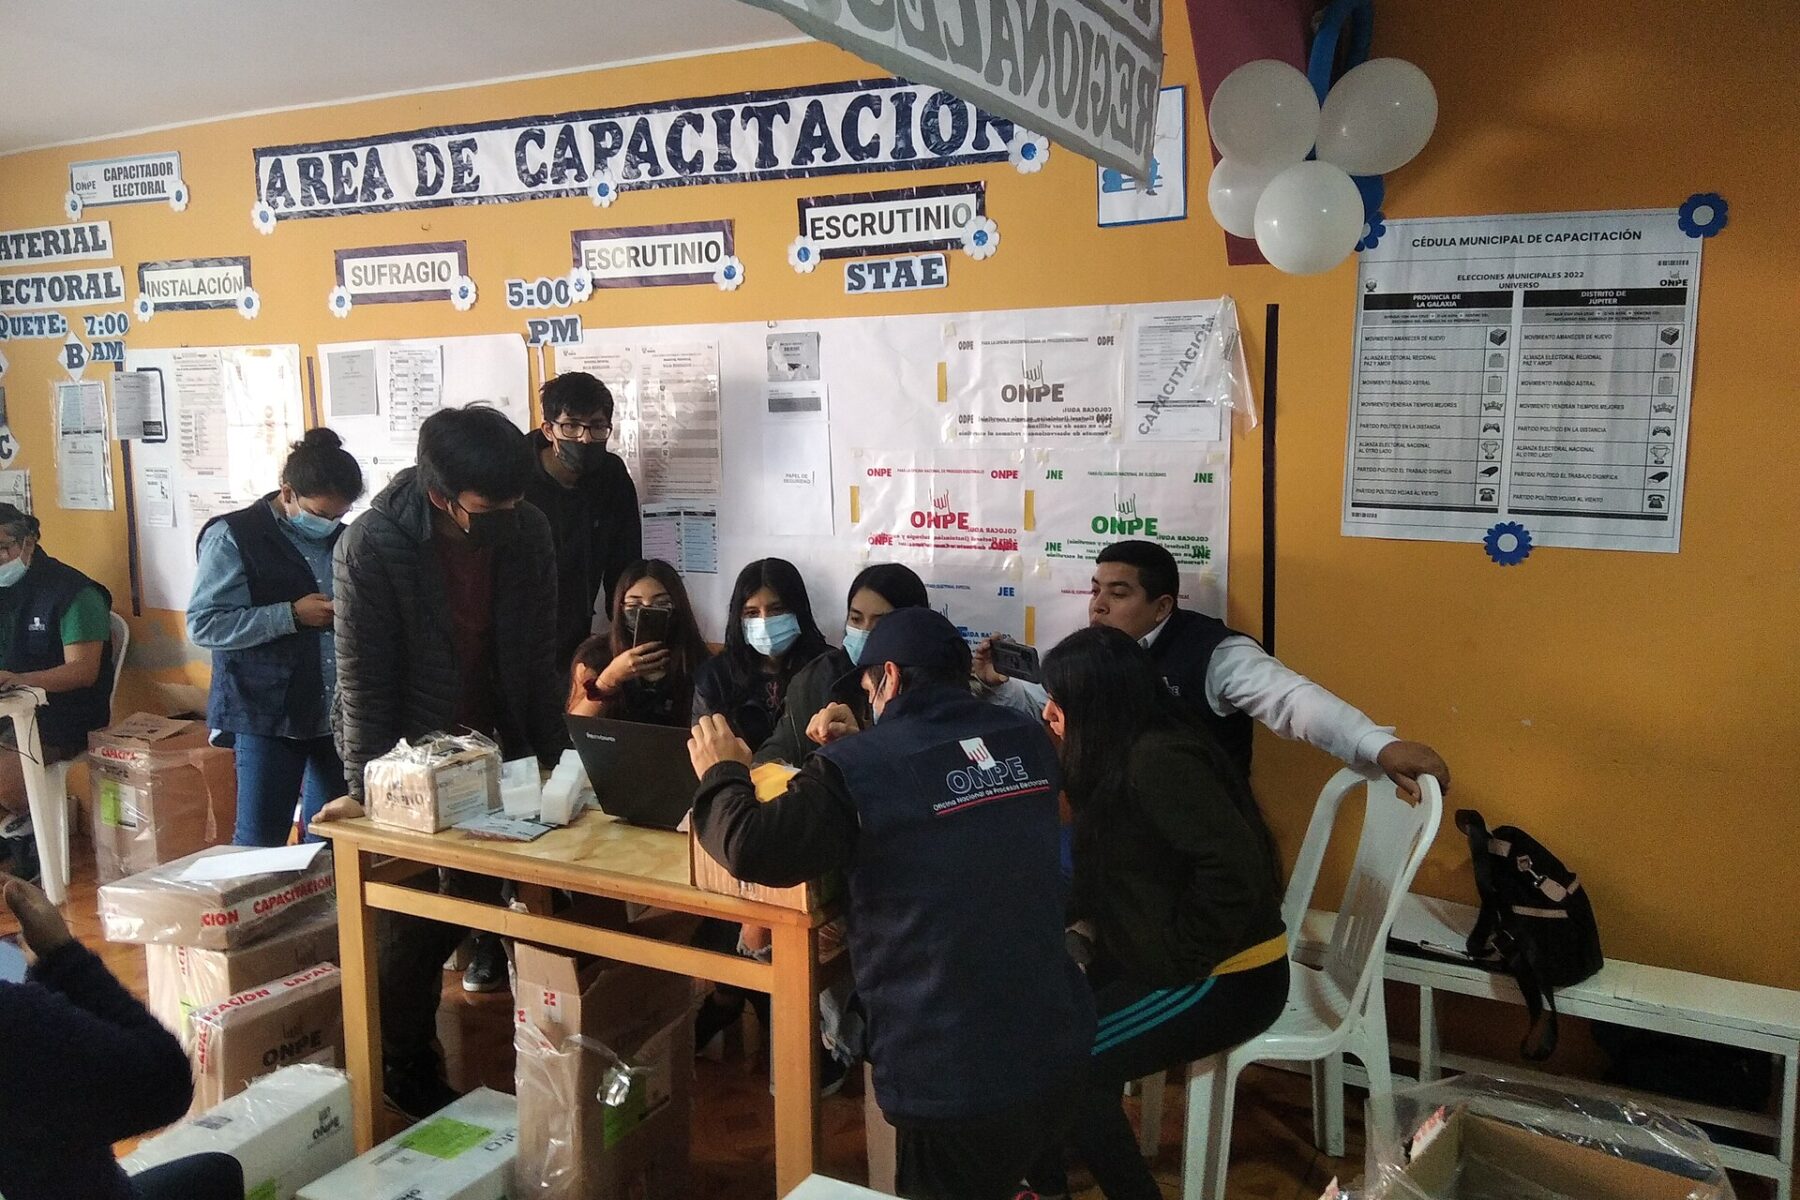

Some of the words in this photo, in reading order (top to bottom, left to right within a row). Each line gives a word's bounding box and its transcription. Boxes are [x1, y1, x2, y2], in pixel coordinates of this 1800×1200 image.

[103, 161, 174, 182] CAPACITADOR
[264, 146, 393, 209] AREA
[412, 138, 482, 198] DE
[75, 180, 97, 191] ONPE
[112, 180, 167, 198] ELECTORAL
[810, 200, 972, 241] ESCRUTINIO
[1412, 236, 1457, 247] CÉDULA
[1459, 234, 1524, 246] MUNICIPAL
[1527, 234, 1542, 243] DE
[1545, 229, 1642, 243] CAPACITACIÓN
[584, 242, 721, 272] ESCRUTINIO
[350, 256, 452, 287] SUFRAGIO
[846, 256, 945, 292] STAE
[1457, 273, 1504, 281] ELECCIONES
[1507, 272, 1561, 280] MUNICIPALES
[146, 272, 243, 298] INSTALACIÓN
[1660, 279, 1688, 287] ONPE
[507, 281, 570, 307] 5:00
[1581, 290, 1614, 298] DISTRITO
[83, 313, 128, 336] 7:00
[528, 316, 580, 345] PM
[958, 341, 974, 350] ODPE
[1097, 336, 1114, 346] ODPE
[64, 342, 85, 369] B
[91, 341, 124, 361] AM
[1001, 383, 1064, 402] ONPE
[958, 414, 974, 424] ODPE
[867, 468, 892, 477] ONPE
[990, 470, 1018, 479] ONPE
[1045, 470, 1063, 480] JNE
[1193, 472, 1213, 483] JNE
[910, 511, 969, 530] ONPE
[1091, 515, 1158, 536] ONPE
[1045, 542, 1062, 552] JNE
[997, 586, 1015, 597] JEE
[946, 756, 1029, 794] ONPE
[933, 800, 957, 811] Oficina
[956, 791, 985, 804] Nacional
[993, 784, 1020, 795] Procesos
[262, 1030, 322, 1067] ONPE
